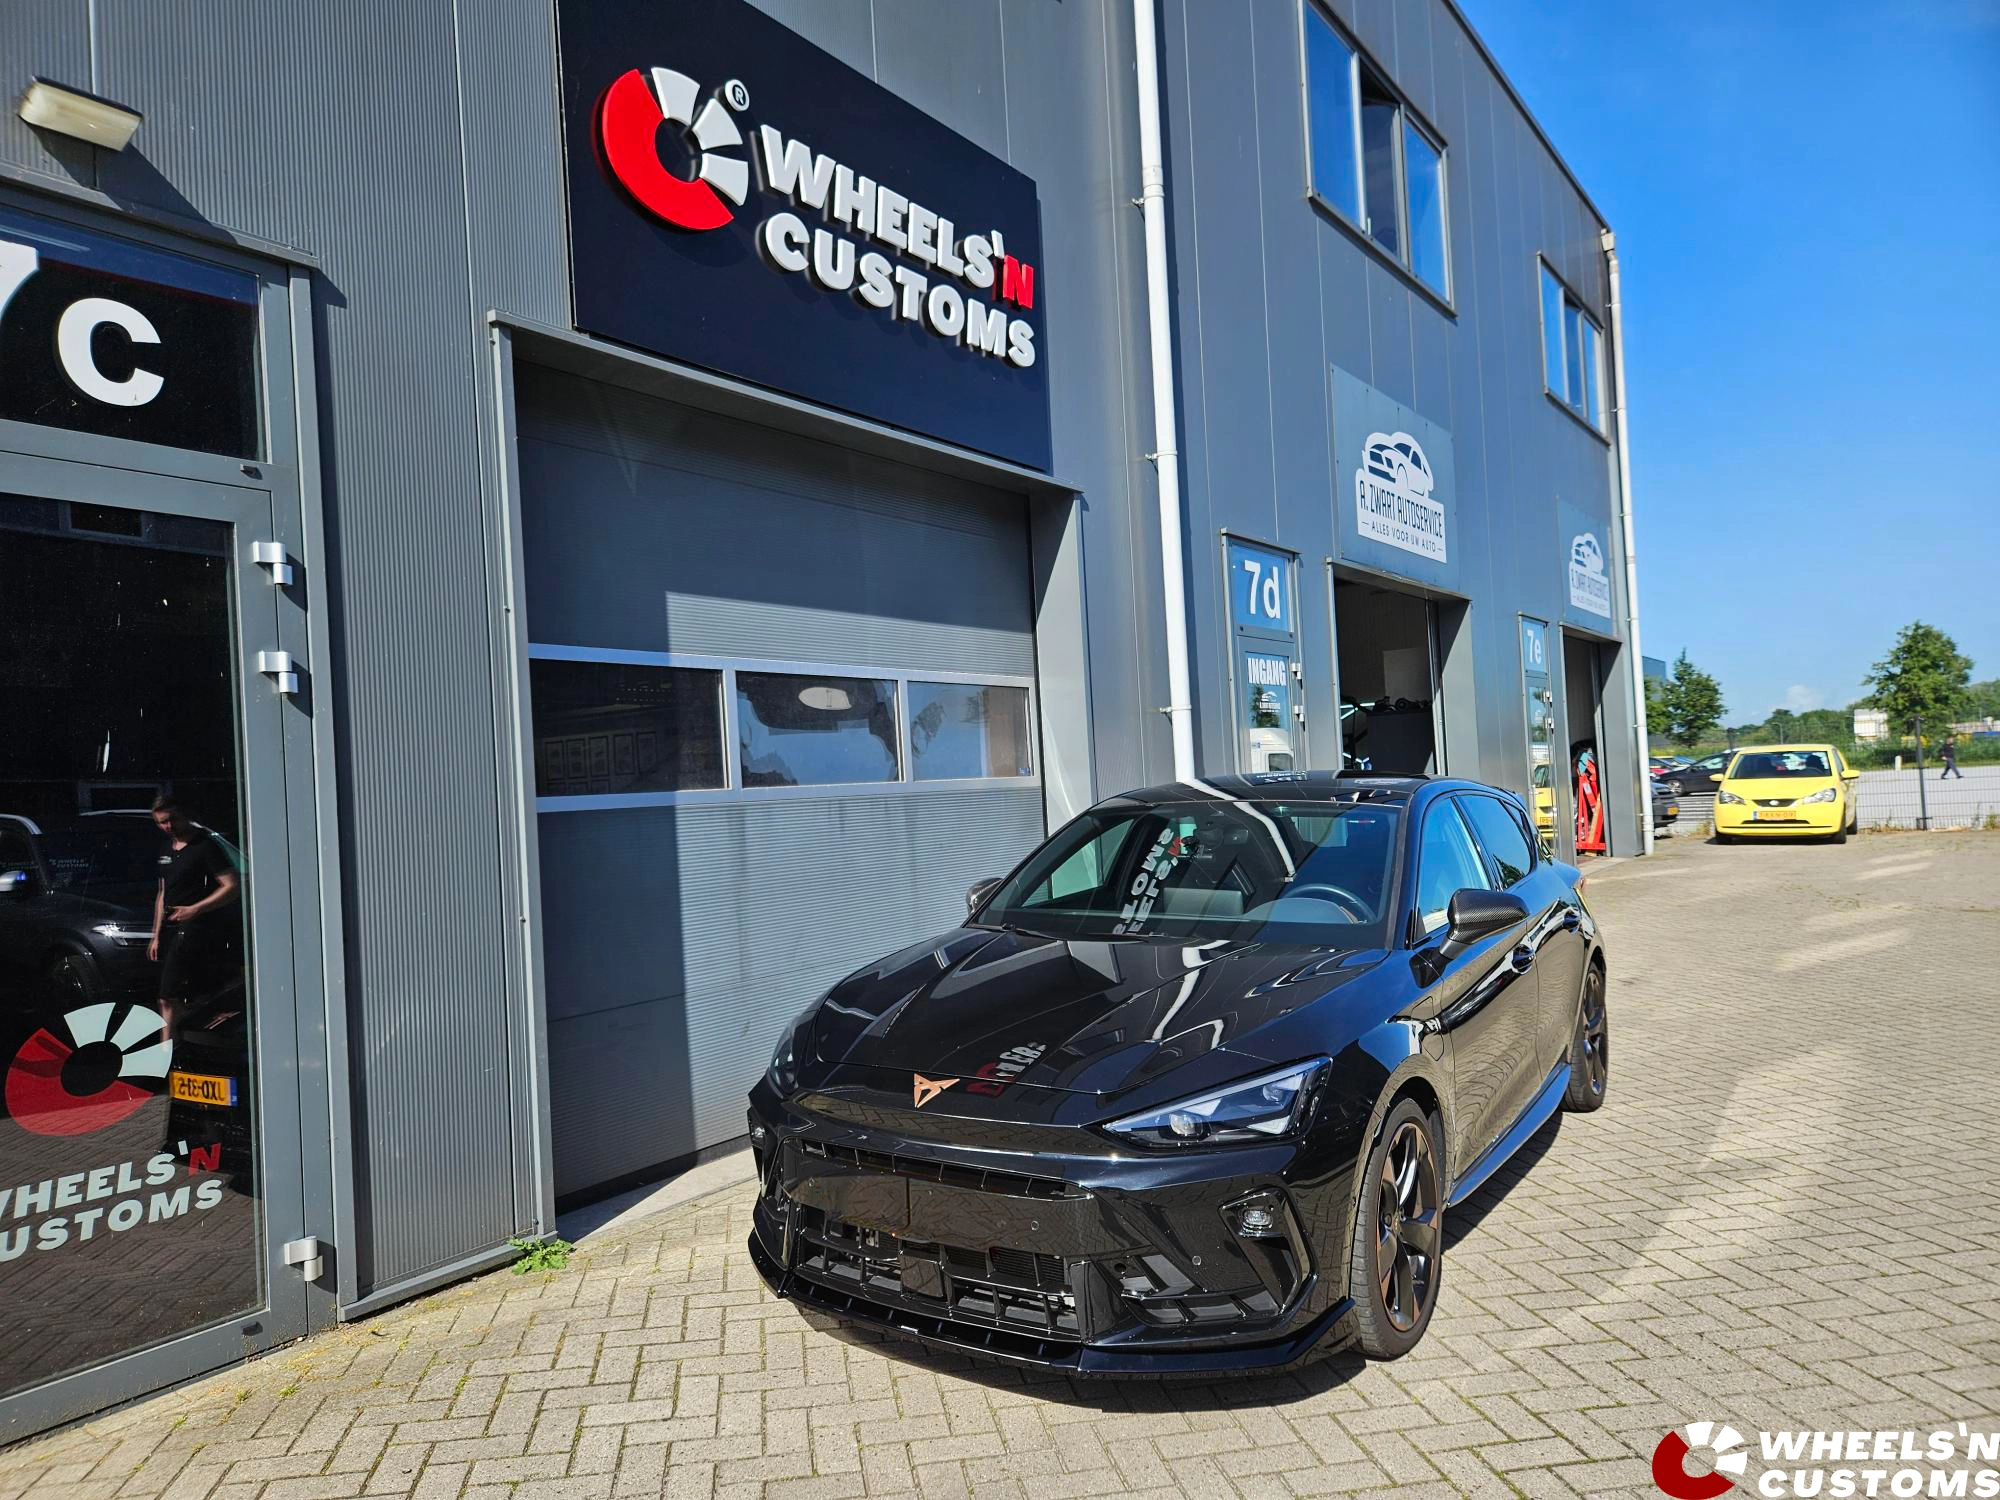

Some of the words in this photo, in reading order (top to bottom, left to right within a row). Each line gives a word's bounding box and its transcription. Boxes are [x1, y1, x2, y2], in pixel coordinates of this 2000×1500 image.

[760, 124, 1034, 309] WHEELS'N
[765, 212, 1036, 368] CUSTOMS
[1369, 483, 1396, 521] ZWART
[1397, 495, 1443, 539] AUTOSERVICE
[1371, 520, 1389, 537] ALLES
[1391, 527, 1409, 543] VOOR
[1421, 538, 1437, 553] AUTO
[1244, 559, 1281, 619] 7d
[1247, 657, 1287, 687] INGANG
[1526, 628, 1541, 664] 7e
[0, 1140, 222, 1219] HEELS'N
[0, 1179, 223, 1262] USTOMS
